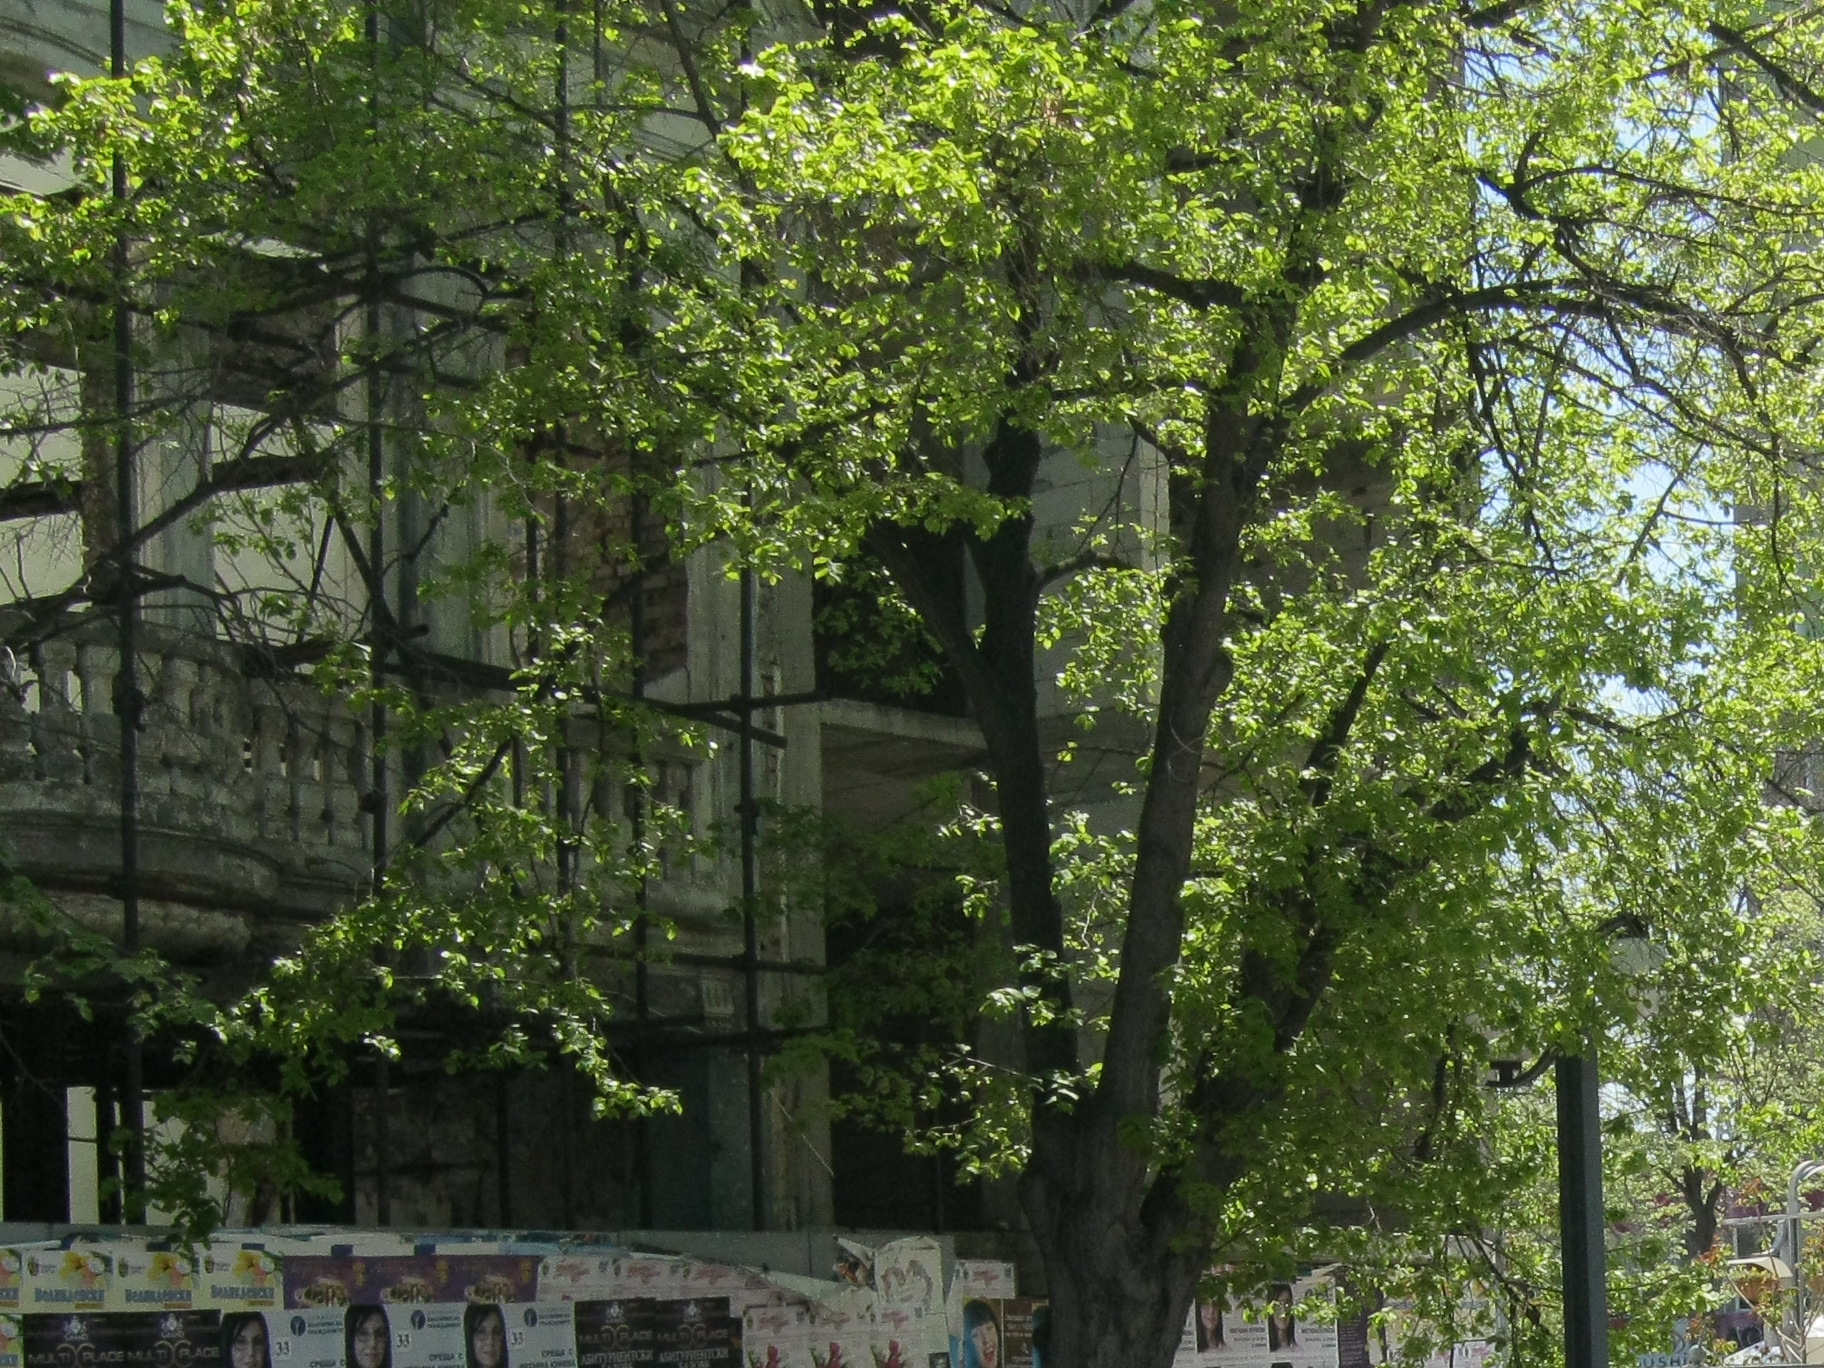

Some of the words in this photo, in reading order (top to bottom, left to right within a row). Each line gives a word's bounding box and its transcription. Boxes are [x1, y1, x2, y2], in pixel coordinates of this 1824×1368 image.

[396, 1333, 411, 1348] 33
[510, 1331, 524, 1346] 33
[127, 1350, 169, 1361] MULTI
[179, 1347, 220, 1359] PLACE
[276, 1341, 291, 1357] 33
[28, 1352, 71, 1365] MULTI
[83, 1350, 125, 1363] PLACE
